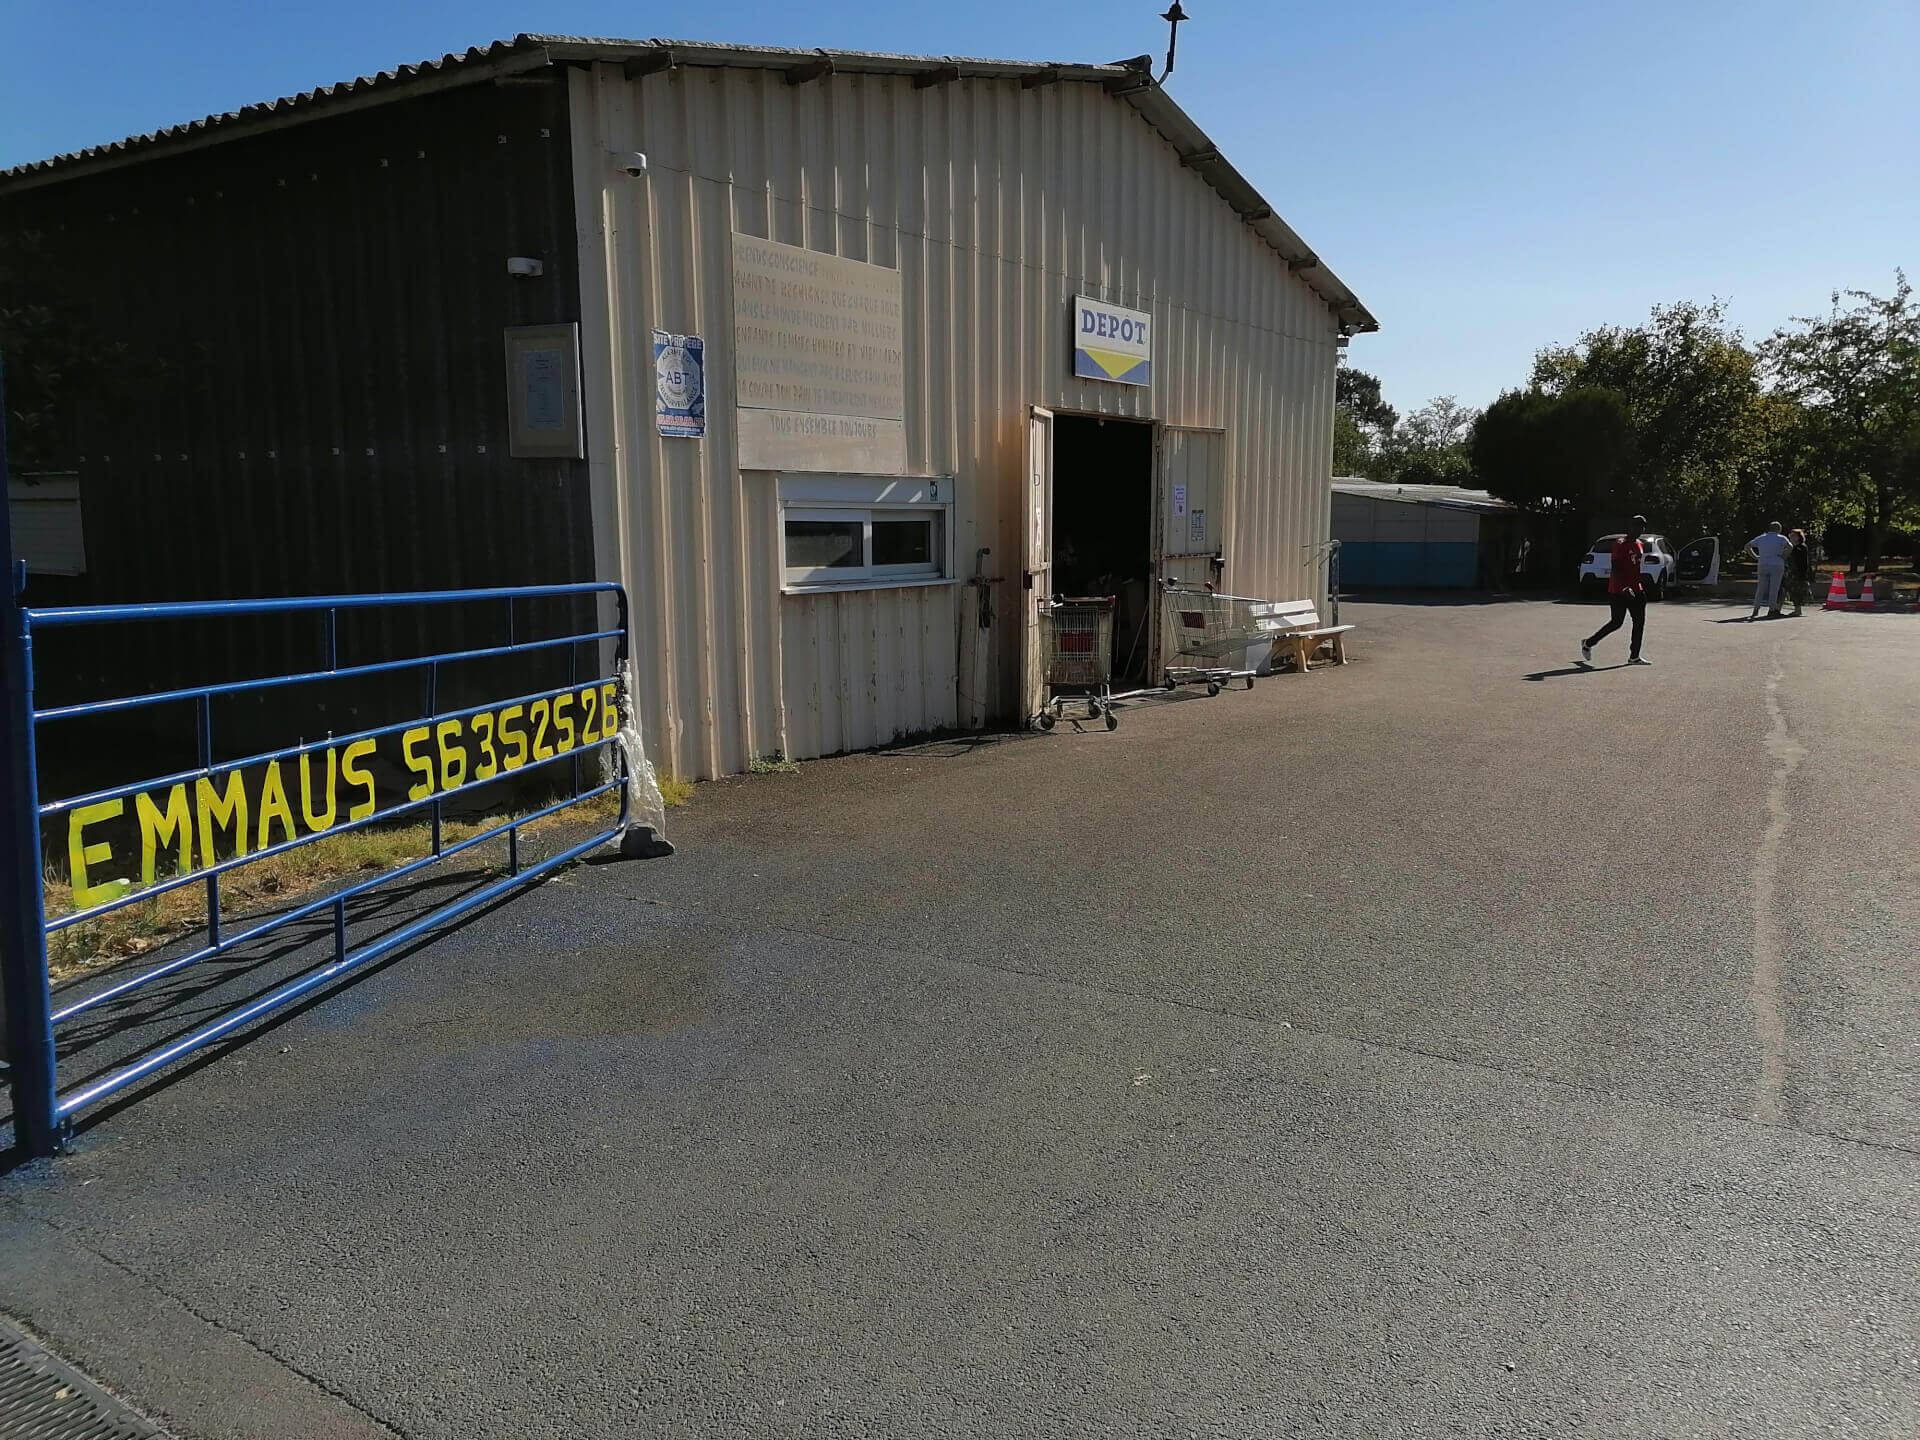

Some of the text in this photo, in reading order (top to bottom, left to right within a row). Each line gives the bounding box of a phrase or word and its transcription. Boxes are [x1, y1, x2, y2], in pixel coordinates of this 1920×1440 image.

[1081, 308, 1146, 345] DEPOT
[664, 371, 689, 386] ABT
[770, 414, 877, 438] TOUS ENSEMBLE TOUJOURS
[67, 738, 377, 910] EMMAUS
